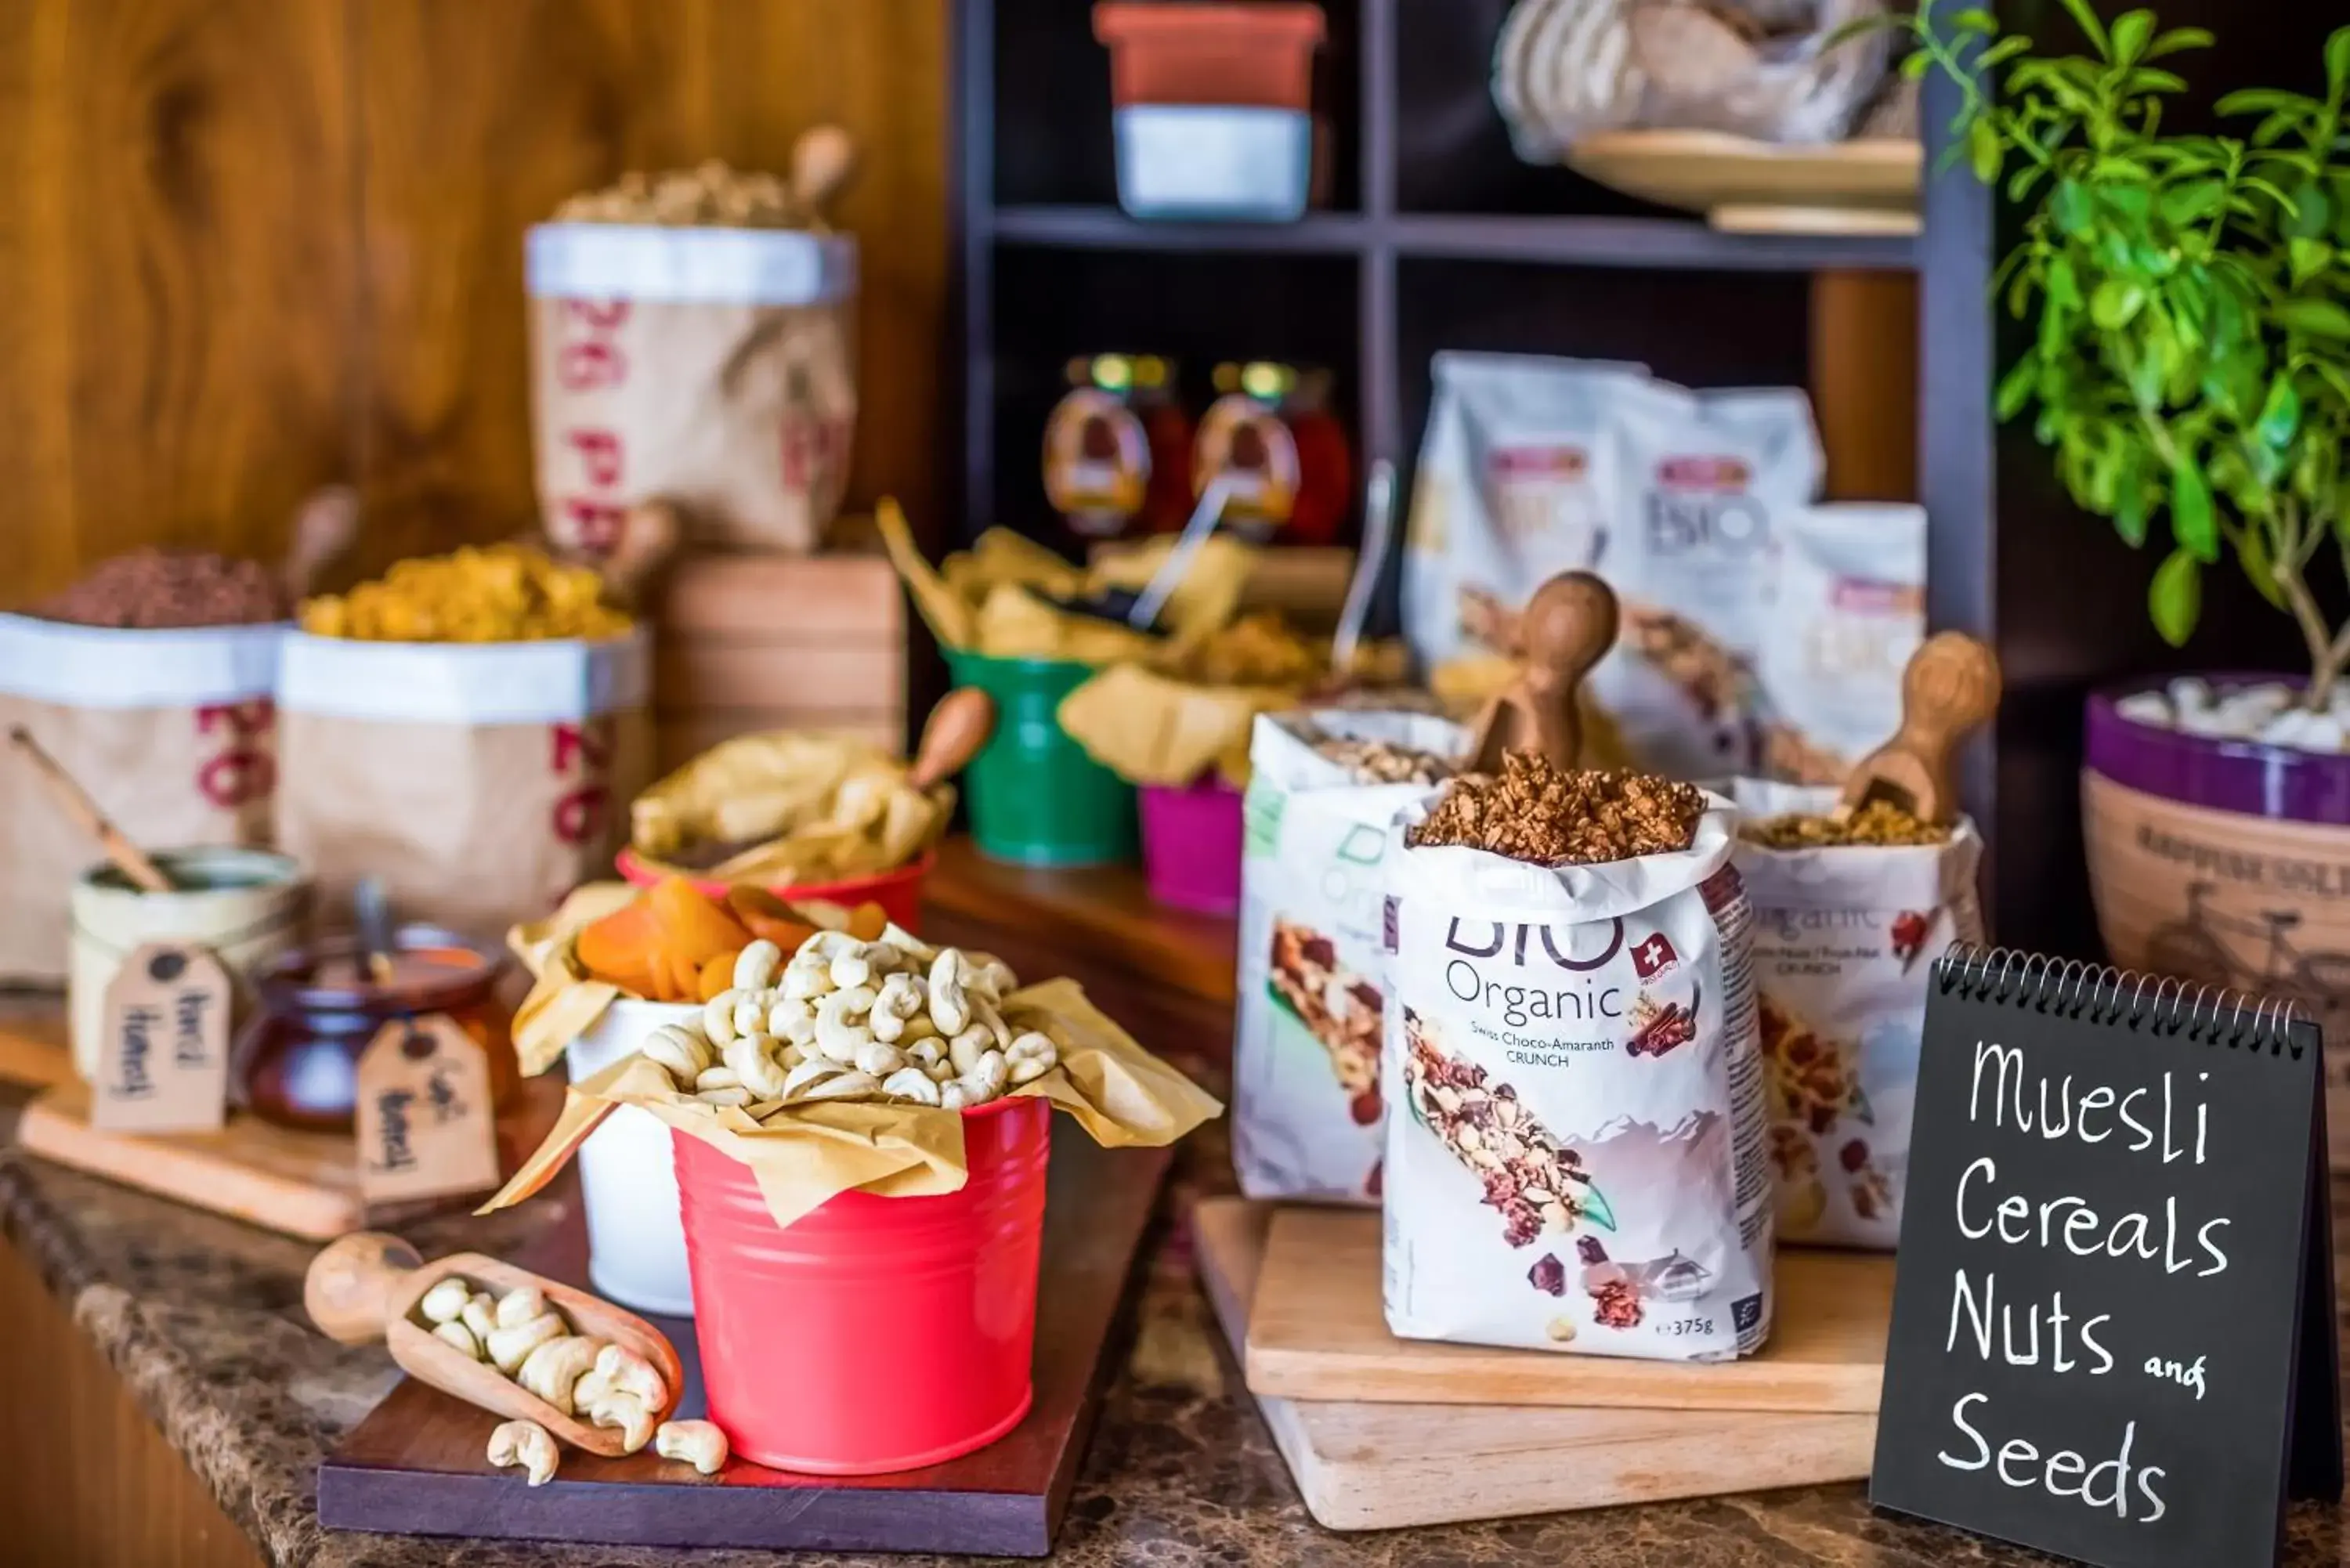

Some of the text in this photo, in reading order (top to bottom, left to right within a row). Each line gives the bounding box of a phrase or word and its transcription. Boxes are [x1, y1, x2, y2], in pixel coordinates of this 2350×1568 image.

[1447, 959, 1622, 1027] Organic
[1470, 1020, 1614, 1051] Swiss Choco-Amaranth
[1506, 1050, 1570, 1068] CRUNCH
[1955, 1157, 2232, 1277] Cereals
[1947, 1268, 2207, 1400] Nuts and
[1936, 1392, 2167, 1523] Seeds
